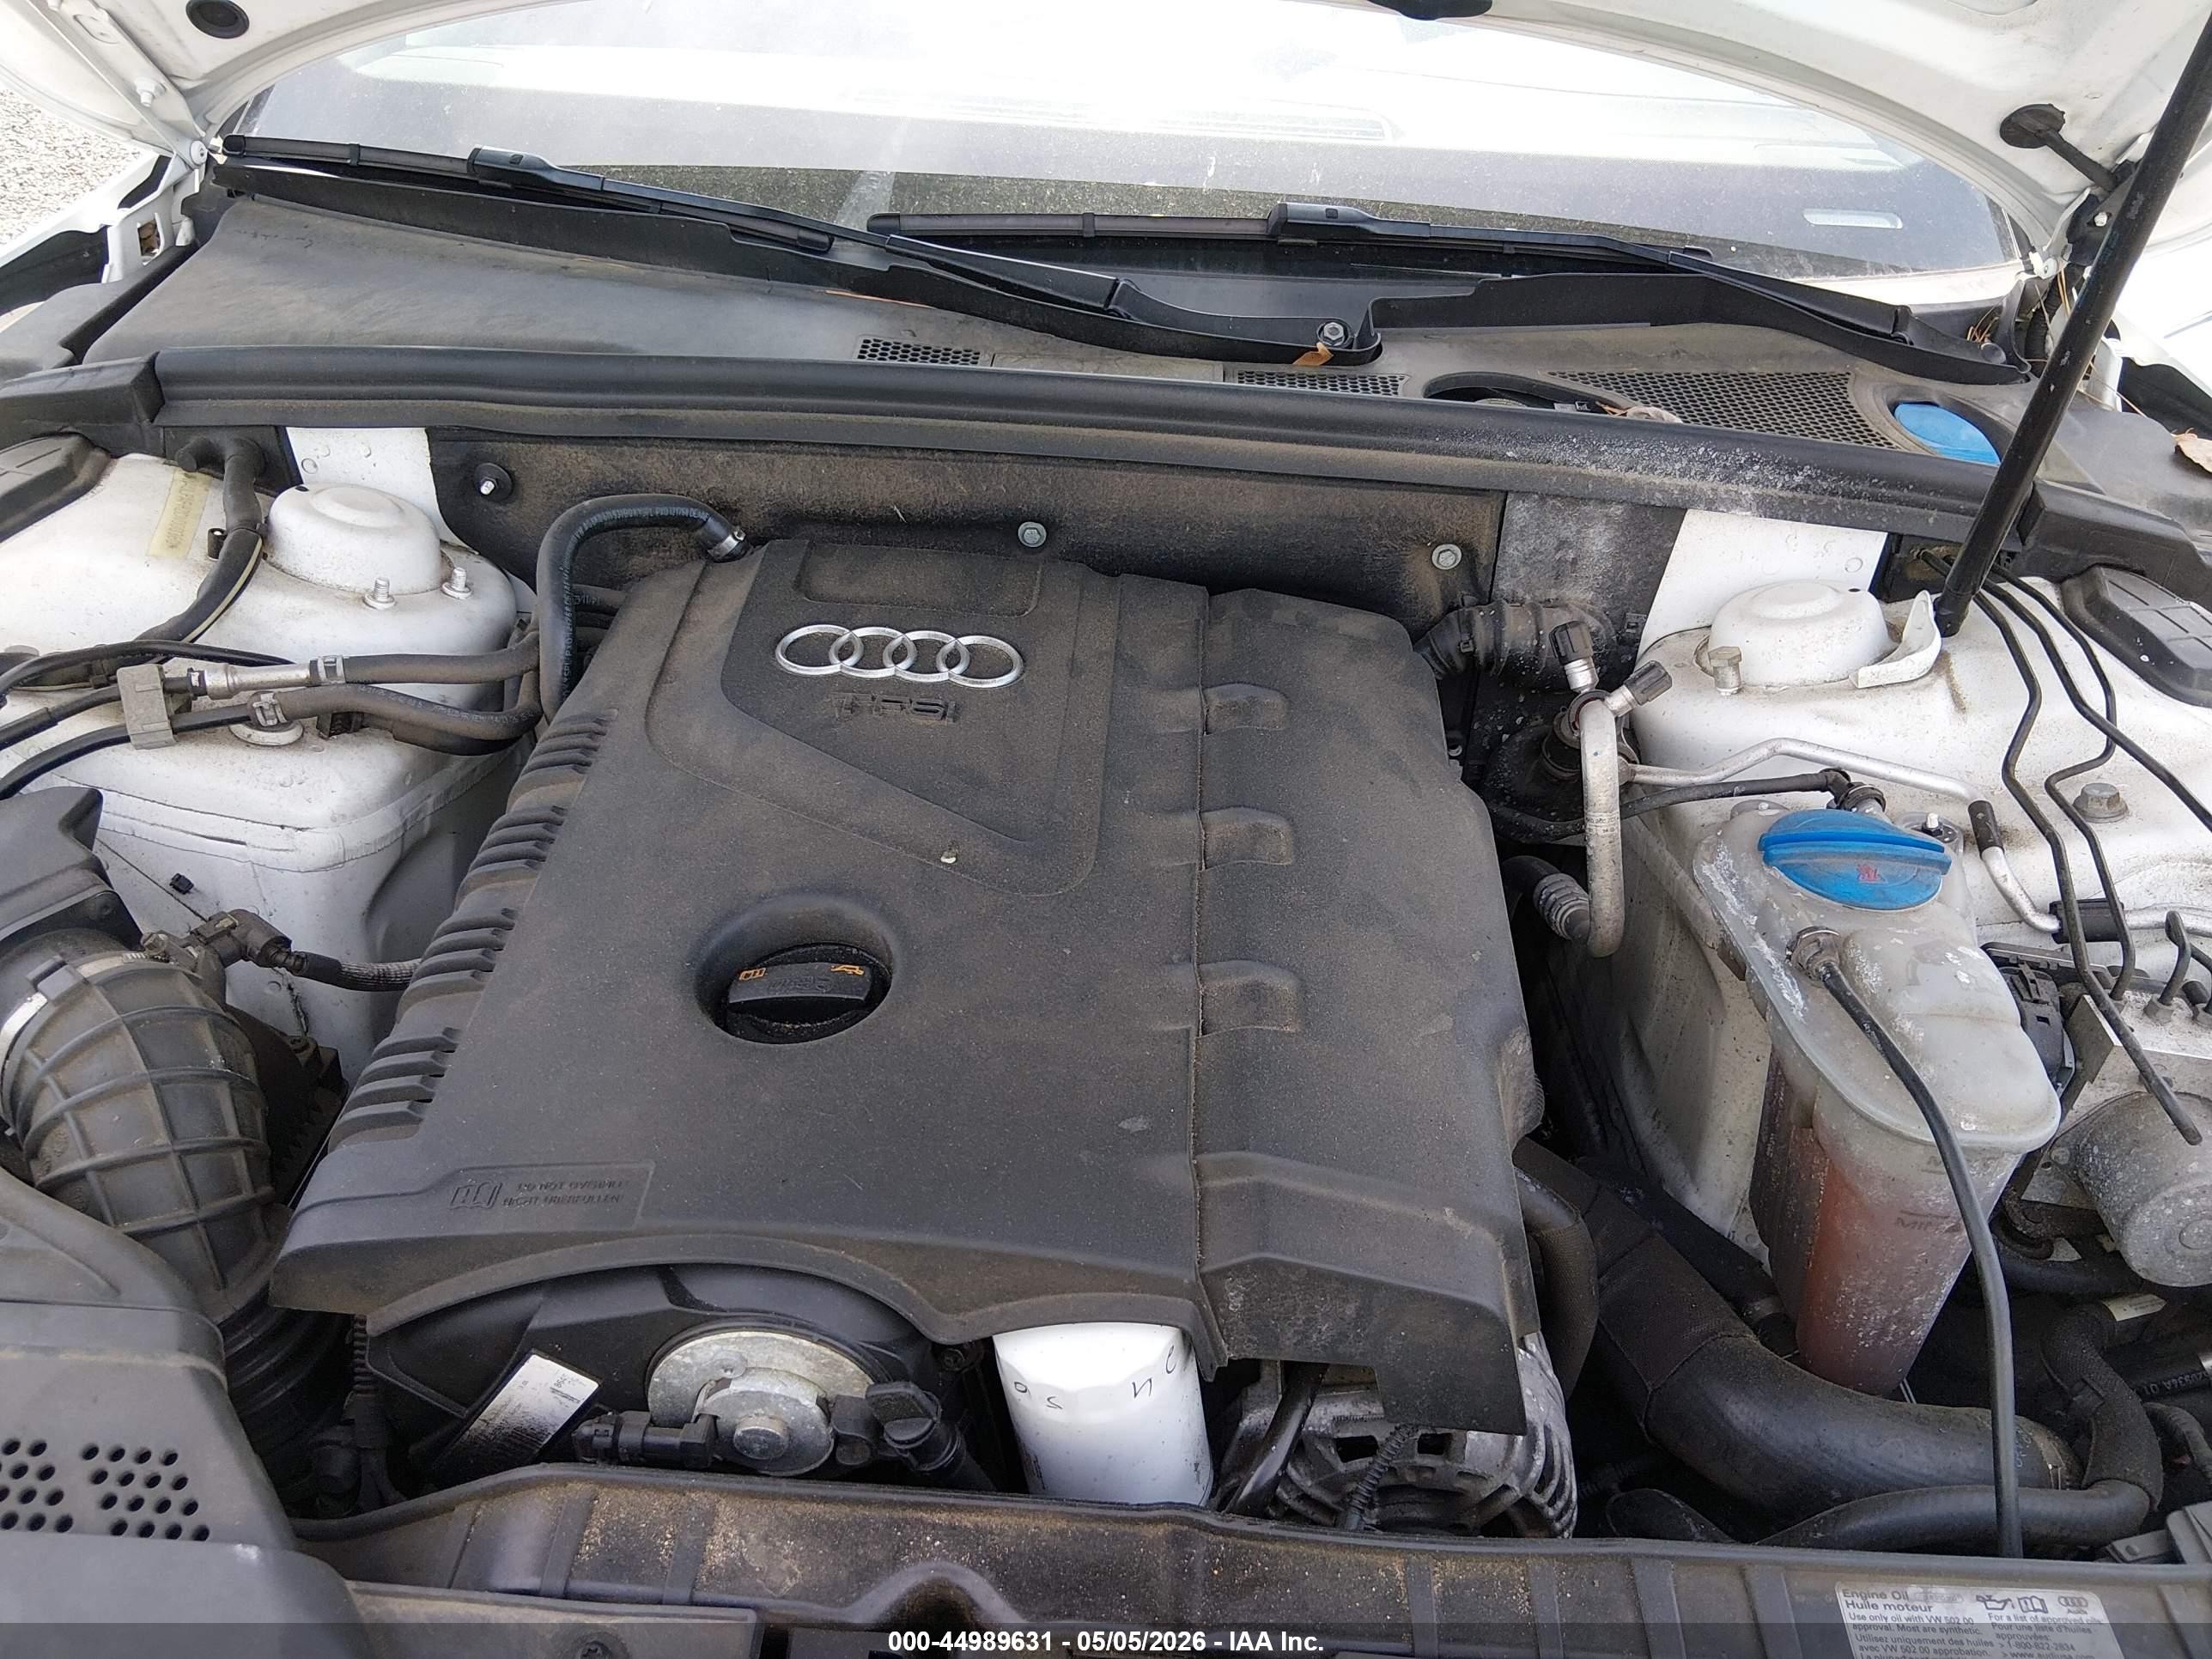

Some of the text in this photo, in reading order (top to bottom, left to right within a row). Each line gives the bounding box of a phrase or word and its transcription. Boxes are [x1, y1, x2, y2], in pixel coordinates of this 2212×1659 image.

[1842, 1589, 1887, 1601] Engine
[1891, 1590, 1910, 1601] Oil
[1844, 1600, 1933, 1613] Huile moteur
[1849, 1613, 1974, 1626] Use only oil with VW 502 00
[1987, 1613, 2004, 1622] For
[2013, 1614, 2028, 1623] list
[1852, 1622, 1895, 1632] approval.
[1896, 1623, 1921, 1633] Most
[1922, 1626, 1937, 1634] are
[1991, 1622, 2013, 1631] Pour
[2014, 1623, 2033, 1632] une
[2033, 1623, 2055, 1632] liste
[1855, 1633, 1995, 1648] Utilisez uniquement des huiles
[1859, 1644, 1881, 1653] avec
[1881, 1644, 1898, 1653] VW
[1899, 1644, 1917, 1654] 502
[1918, 1645, 1930, 1655] 00
